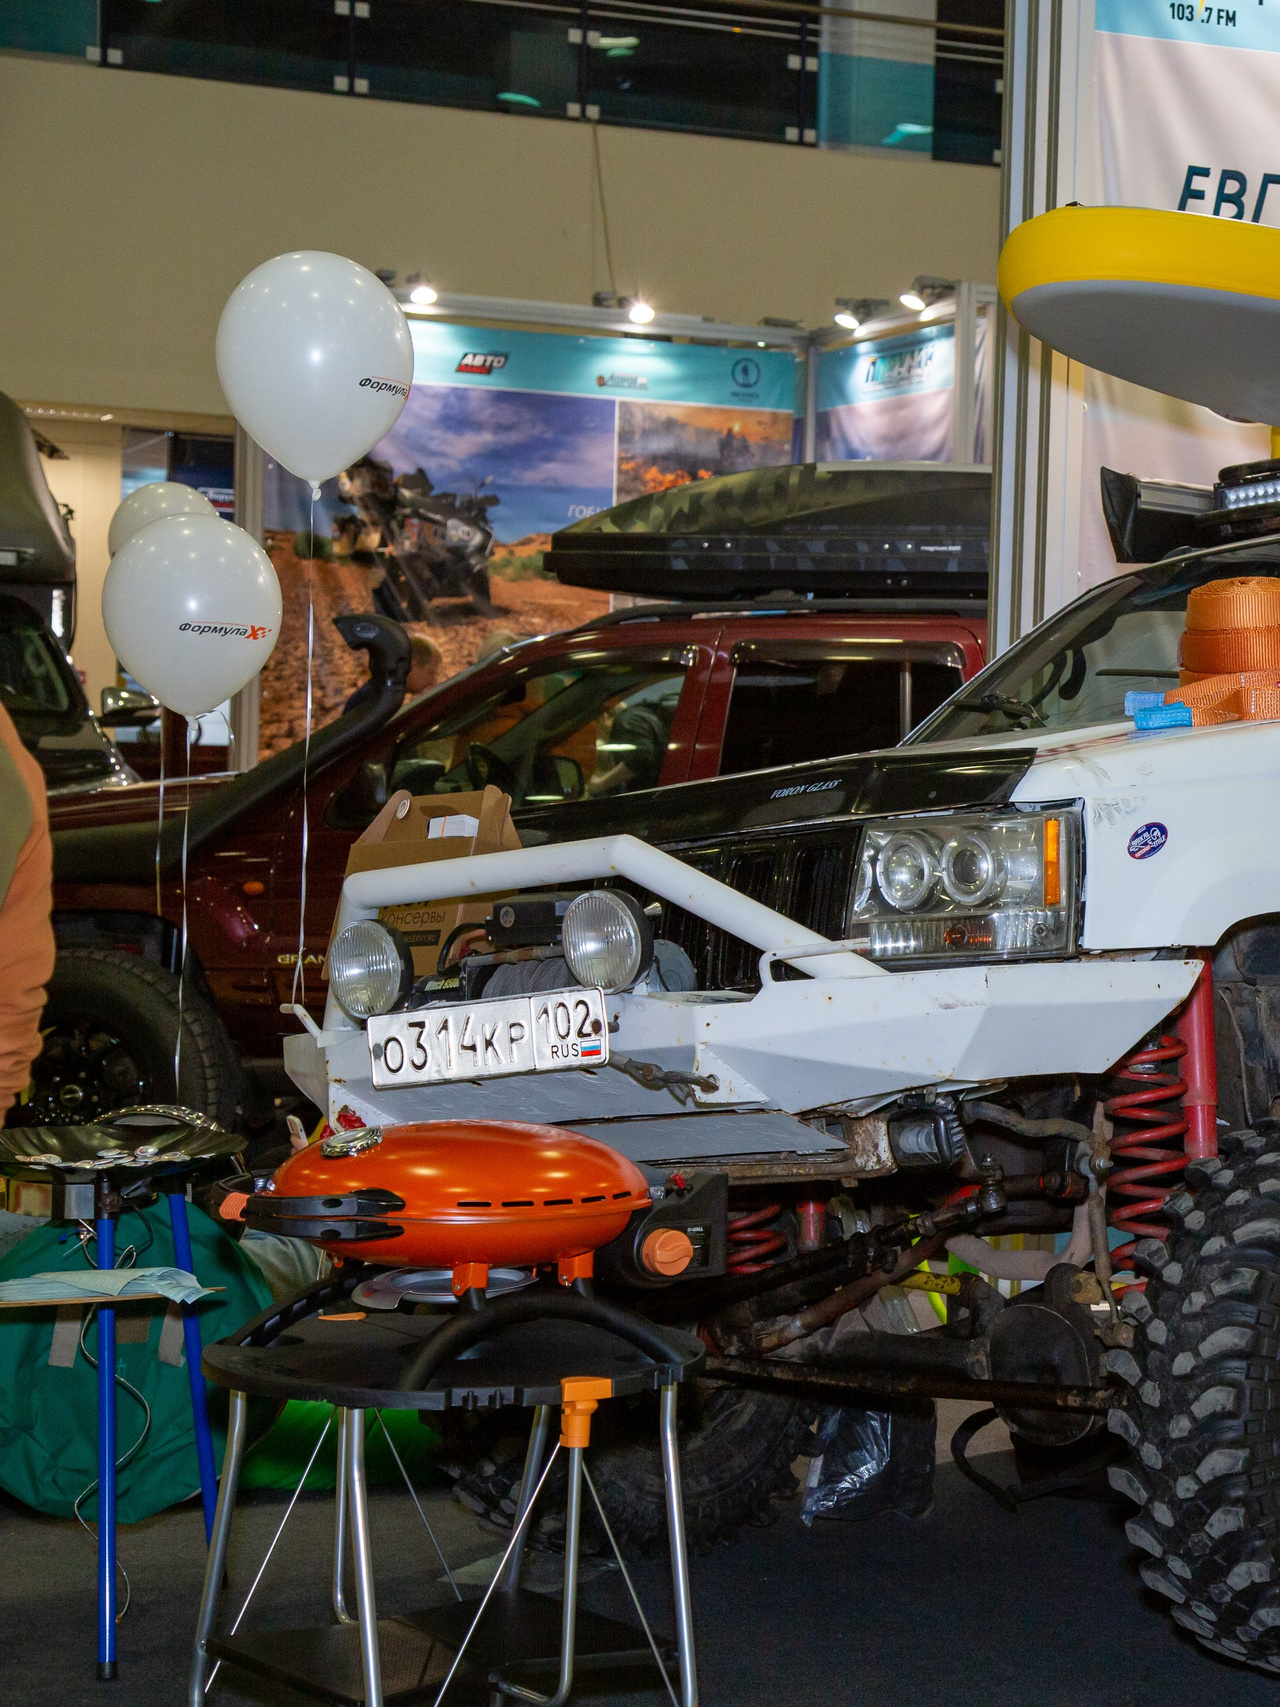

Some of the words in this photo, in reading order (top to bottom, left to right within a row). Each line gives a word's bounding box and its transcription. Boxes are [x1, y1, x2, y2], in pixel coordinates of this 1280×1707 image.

[1217, 8, 1236, 27] FM
[359, 378, 411, 400] Формула
[277, 953, 326, 965] GRAN
[536, 999, 593, 1043] 102
[551, 1042, 580, 1060] RUS
